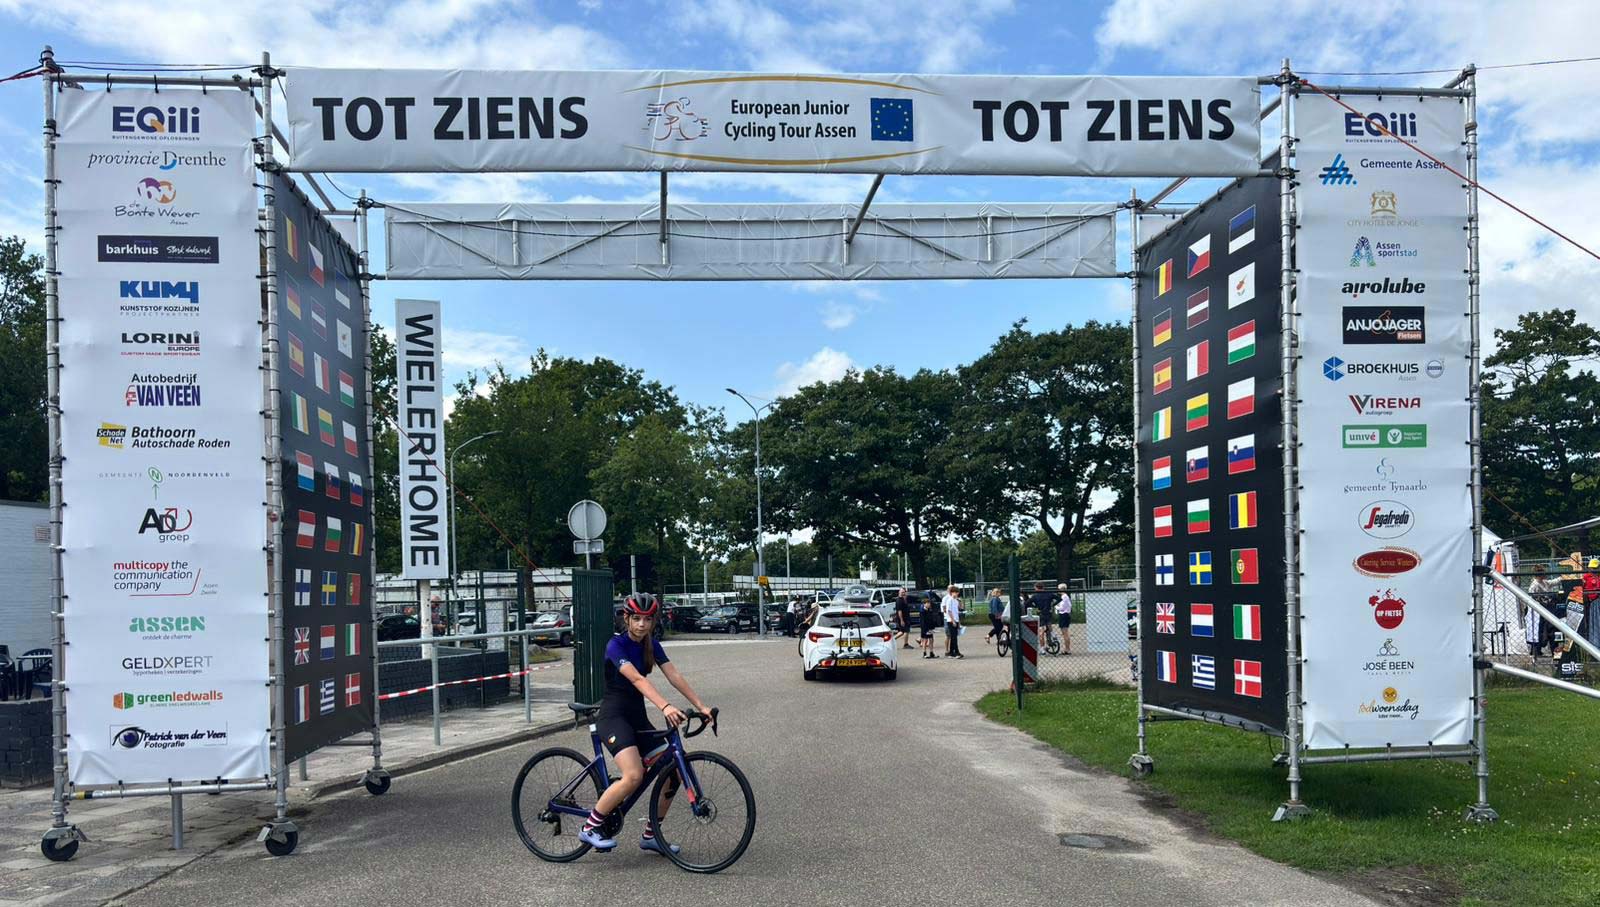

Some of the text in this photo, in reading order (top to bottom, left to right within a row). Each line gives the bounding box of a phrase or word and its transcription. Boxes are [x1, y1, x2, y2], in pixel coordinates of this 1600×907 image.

[731, 99, 849, 119] European Junior
[112, 106, 200, 134] EQili
[312, 96, 589, 141] TOT ZIENS
[972, 99, 1234, 142] TOT ZIENS
[1344, 112, 1417, 137] EQili
[724, 121, 856, 141] Cycling Tour Assen
[88, 150, 226, 171] provincie Drenthe
[1360, 158, 1446, 170] Gemeente Assen
[129, 200, 140, 208] de
[114, 205, 200, 218] Bonte Wever
[106, 244, 159, 255] barkhuis
[1376, 242, 1401, 250] Assen
[1378, 249, 1418, 258] sportstad
[1397, 332, 1422, 340] Fietsen
[1347, 363, 1419, 374] BROEKHUIS
[131, 373, 197, 386] Autobedrijf
[136, 385, 201, 407] VAN VEEN
[1348, 394, 1421, 415] VIRENA
[132, 426, 196, 438] Bathoorn
[1349, 432, 1376, 442] univé
[110, 437, 123, 445] Net
[132, 438, 231, 449] Autoschade Roden
[404, 313, 440, 567] WIELERHOME
[1343, 479, 1427, 494] gemeente Tynaarlo
[1364, 507, 1410, 530] Segafredo
[158, 534, 190, 543] groep
[113, 559, 189, 572] multicopy the
[113, 570, 193, 580] communication
[114, 581, 161, 592] company
[122, 655, 213, 670] GELDXPERT
[1362, 659, 1414, 671] JOSÉ BEEN
[137, 690, 223, 705] greenledwalls
[143, 729, 227, 741] Patrick van der Veen
[144, 740, 185, 749] Fotografie
